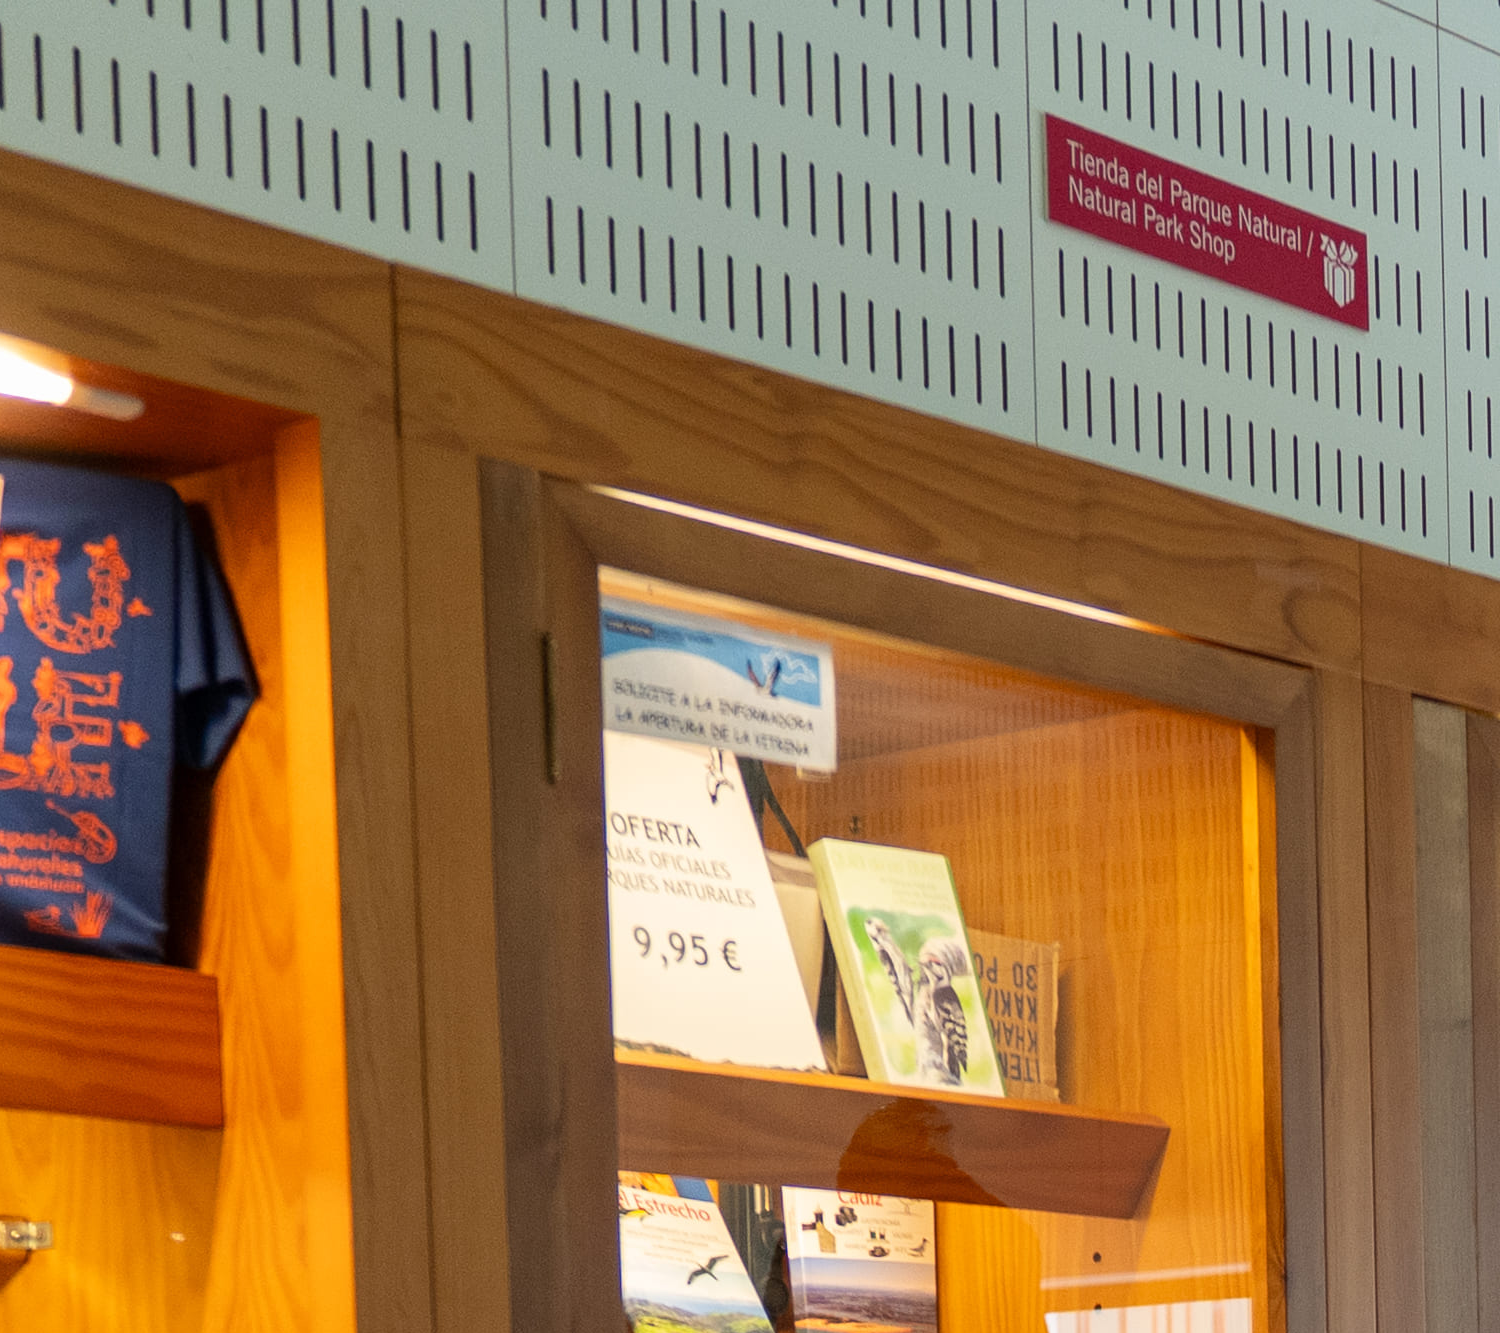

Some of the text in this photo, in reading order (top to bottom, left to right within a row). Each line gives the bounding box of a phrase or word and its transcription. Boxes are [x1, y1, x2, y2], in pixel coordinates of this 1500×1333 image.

[1066, 138, 1129, 190] Tienda
[1136, 168, 1163, 201] del
[1170, 180, 1233, 227] Parque
[1238, 203, 1301, 253] Natural
[1068, 175, 1236, 266] Natural Park Shop
[611, 812, 701, 849] OFERTA
[650, 850, 733, 880] OFICIALES
[662, 877, 757, 907] NATURALES
[633, 926, 742, 971] 9,95 €
[632, 1193, 711, 1222] Estrecho
